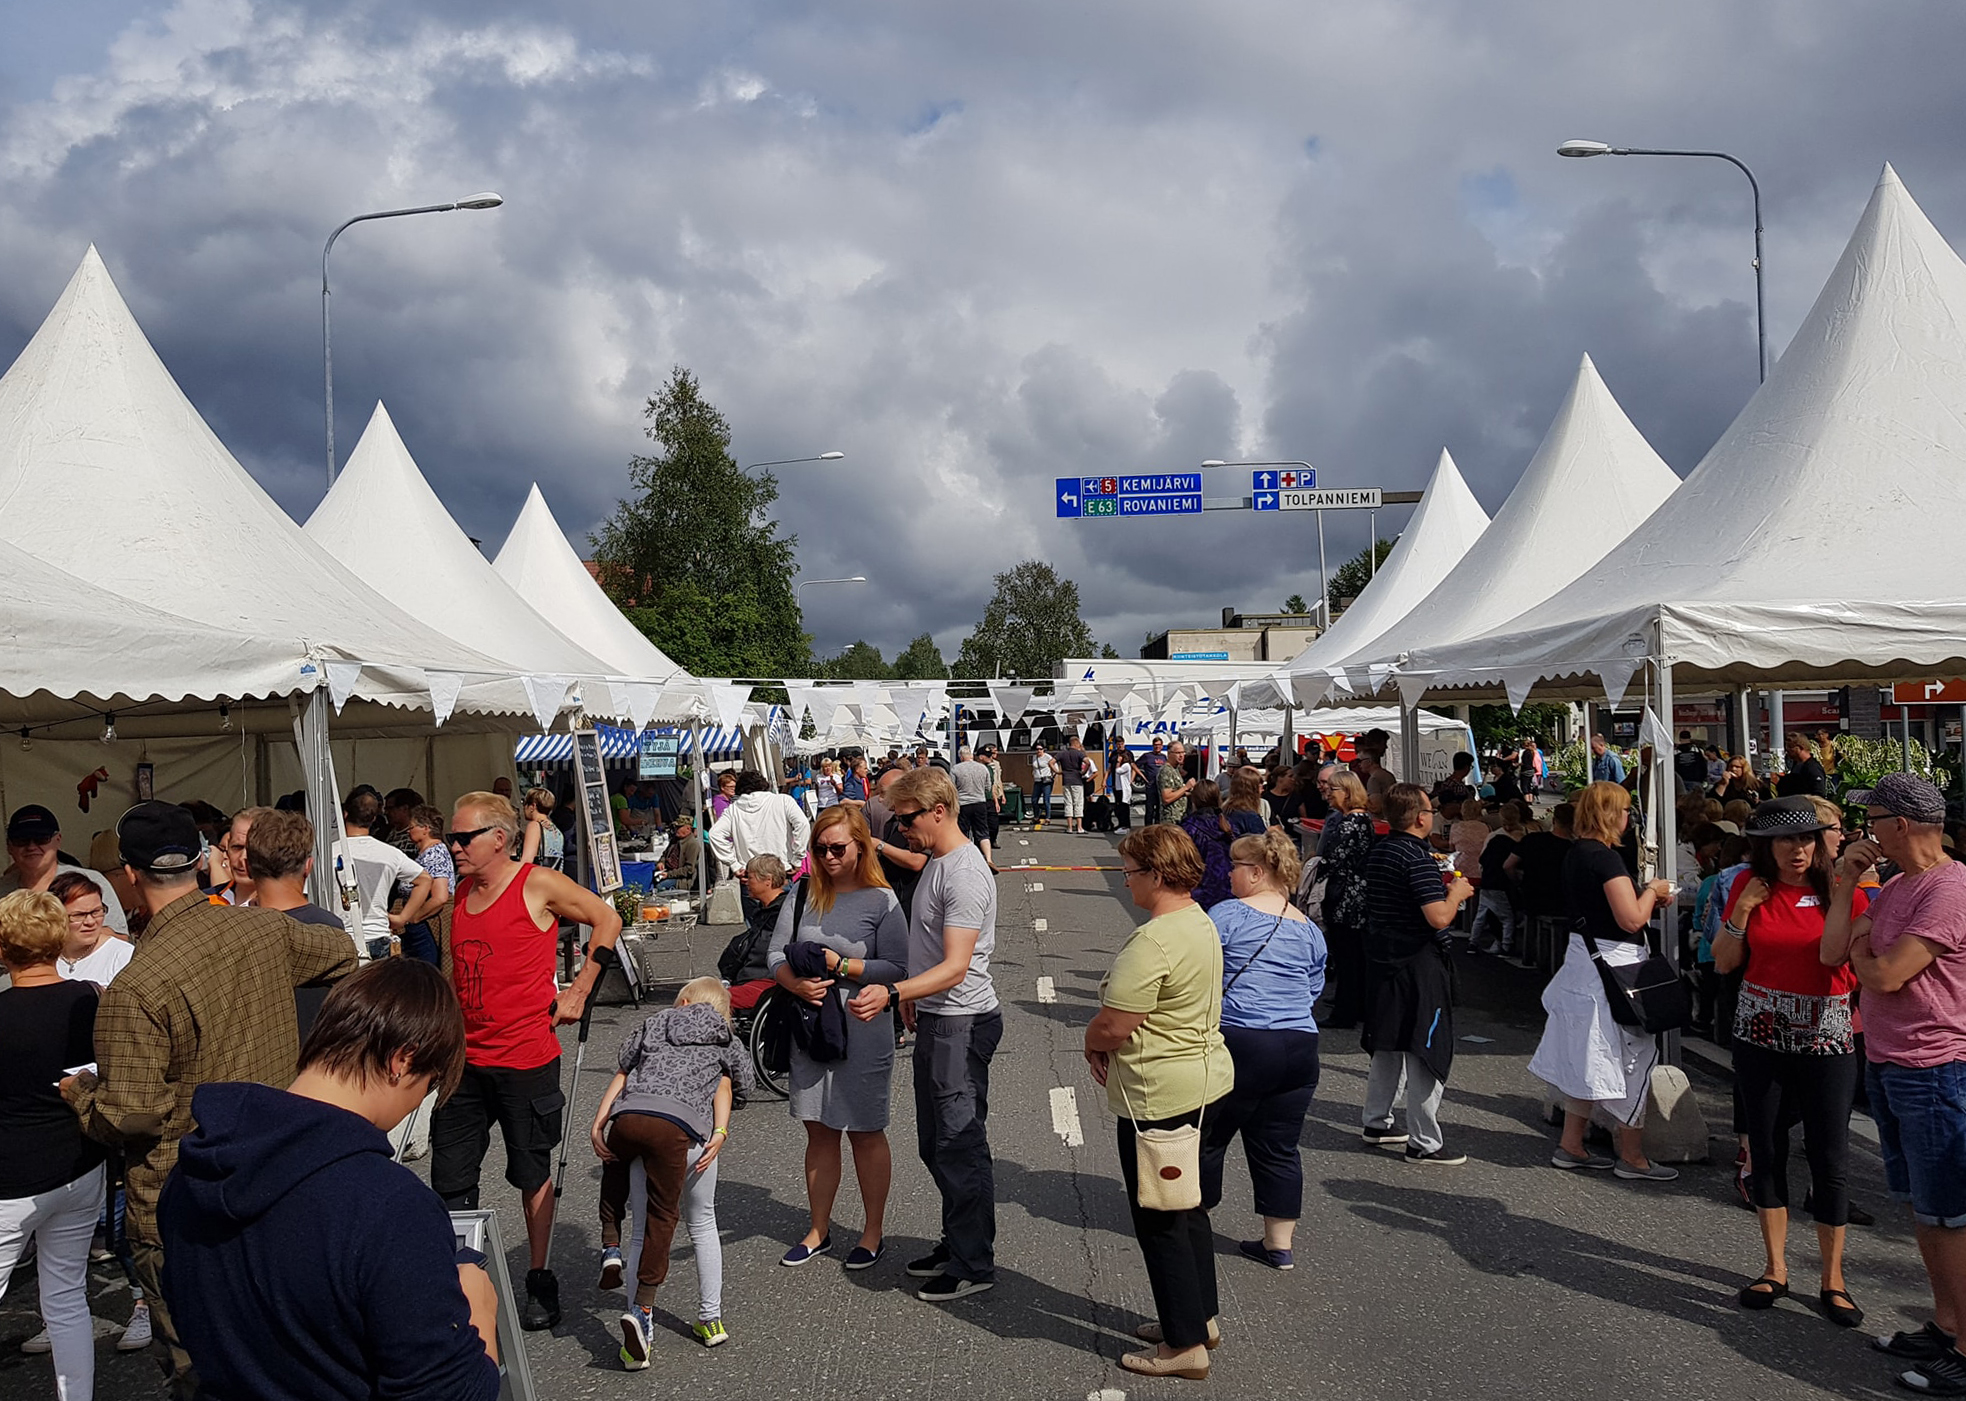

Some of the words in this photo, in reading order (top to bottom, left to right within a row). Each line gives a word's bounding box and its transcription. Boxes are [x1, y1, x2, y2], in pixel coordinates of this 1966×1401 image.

[1105, 480, 1112, 492] 5
[1123, 476, 1194, 491] KEMIJÄRVI
[1301, 473, 1311, 486] P
[1123, 498, 1197, 512] ROVANIEMI
[1285, 492, 1376, 506] TOLPANNIEMI
[1088, 501, 1095, 513] E
[1099, 501, 1113, 513] 63
